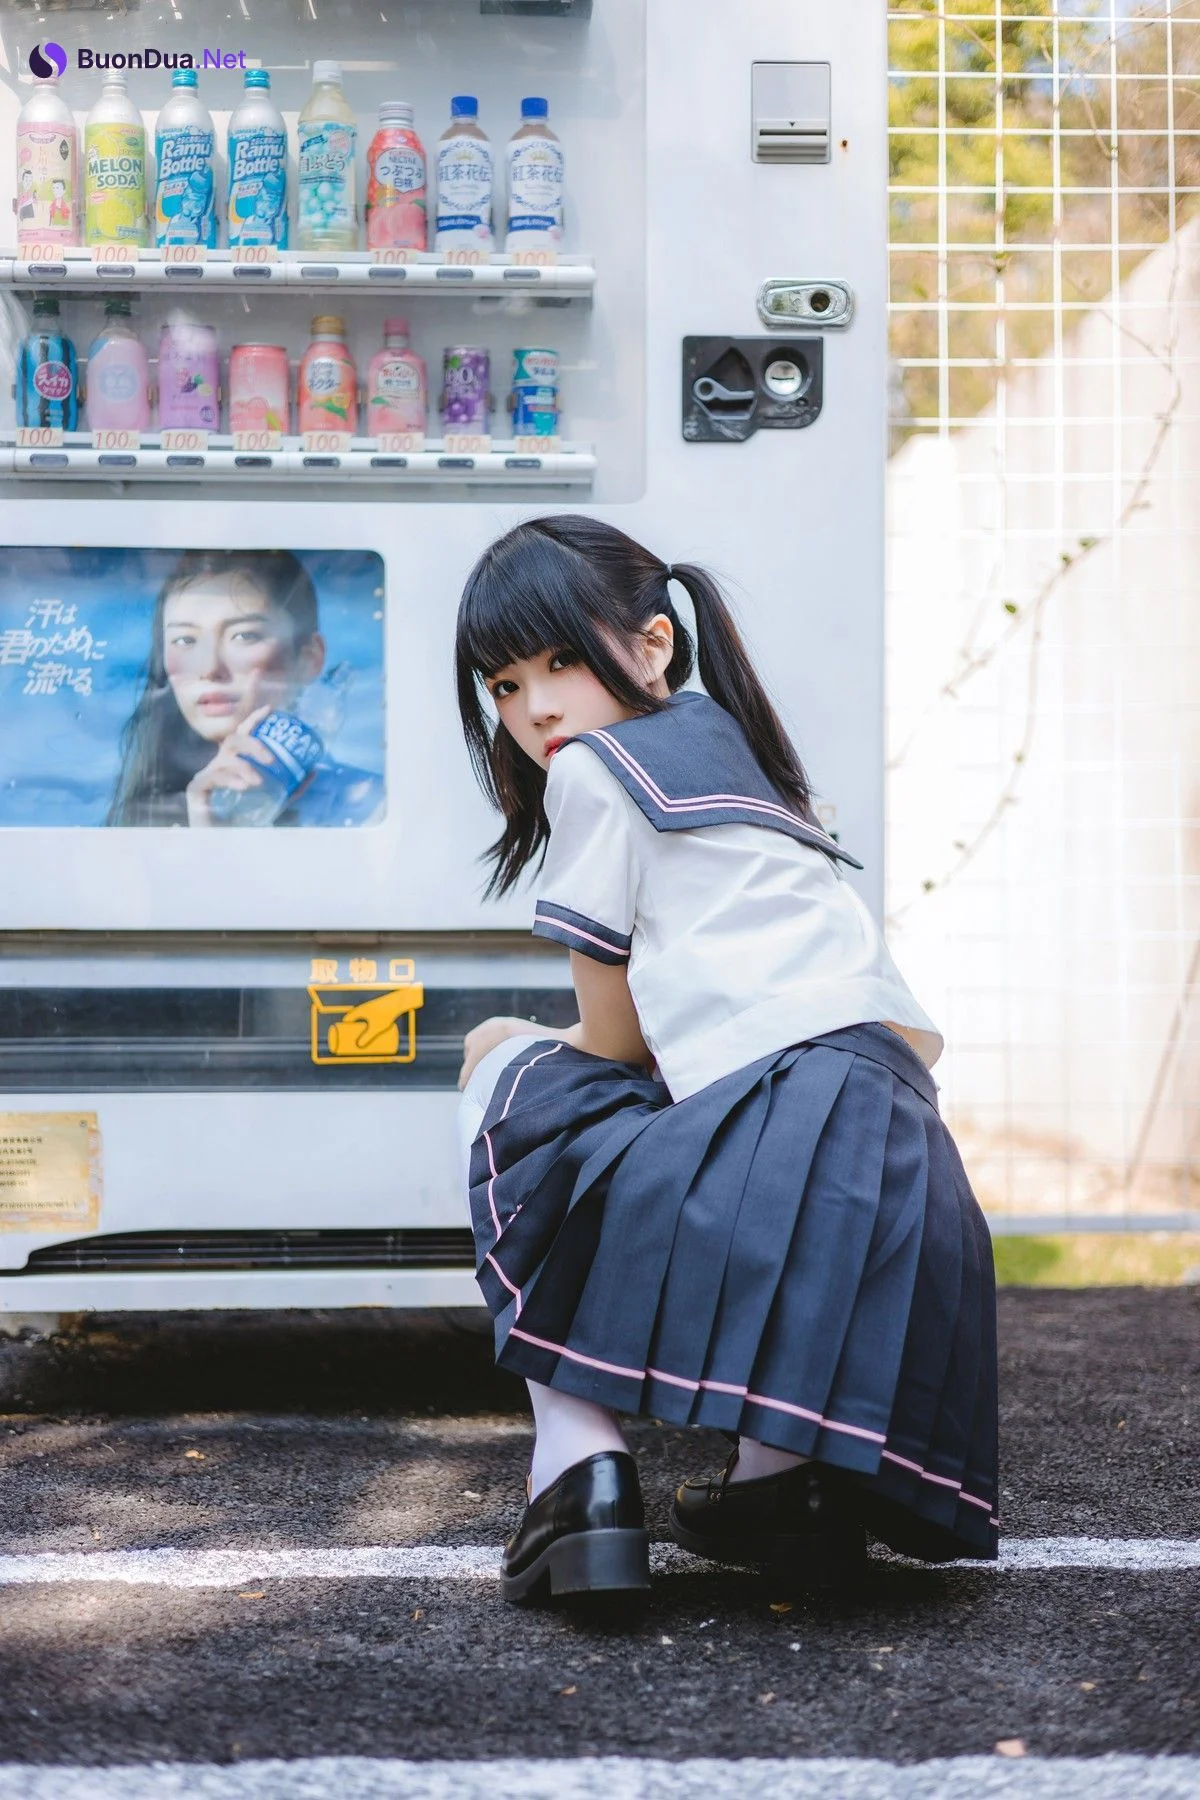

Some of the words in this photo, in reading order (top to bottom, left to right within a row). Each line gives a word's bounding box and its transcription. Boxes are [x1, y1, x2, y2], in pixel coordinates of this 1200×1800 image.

[161, 139, 210, 158] Ramu
[235, 140, 284, 160] Ramu
[88, 157, 143, 176] MELON
[160, 155, 205, 180] Bottle
[233, 156, 278, 182] Bottle
[96, 174, 138, 188] SODA
[22, 245, 53, 262] 100
[94, 246, 128, 262] 100
[164, 246, 195, 262] 100
[236, 247, 267, 263] 100
[374, 250, 407, 264] 100
[37, 374, 68, 386] スイカ
[18, 429, 53, 446] 100
[97, 432, 128, 449] 100
[164, 433, 198, 450] 100
[238, 433, 270, 449] 100
[308, 434, 339, 450] 100
[382, 435, 413, 450] 100
[24, 599, 78, 629] 汗は
[0, 625, 108, 665] 君のために
[23, 661, 92, 697] 流れる
